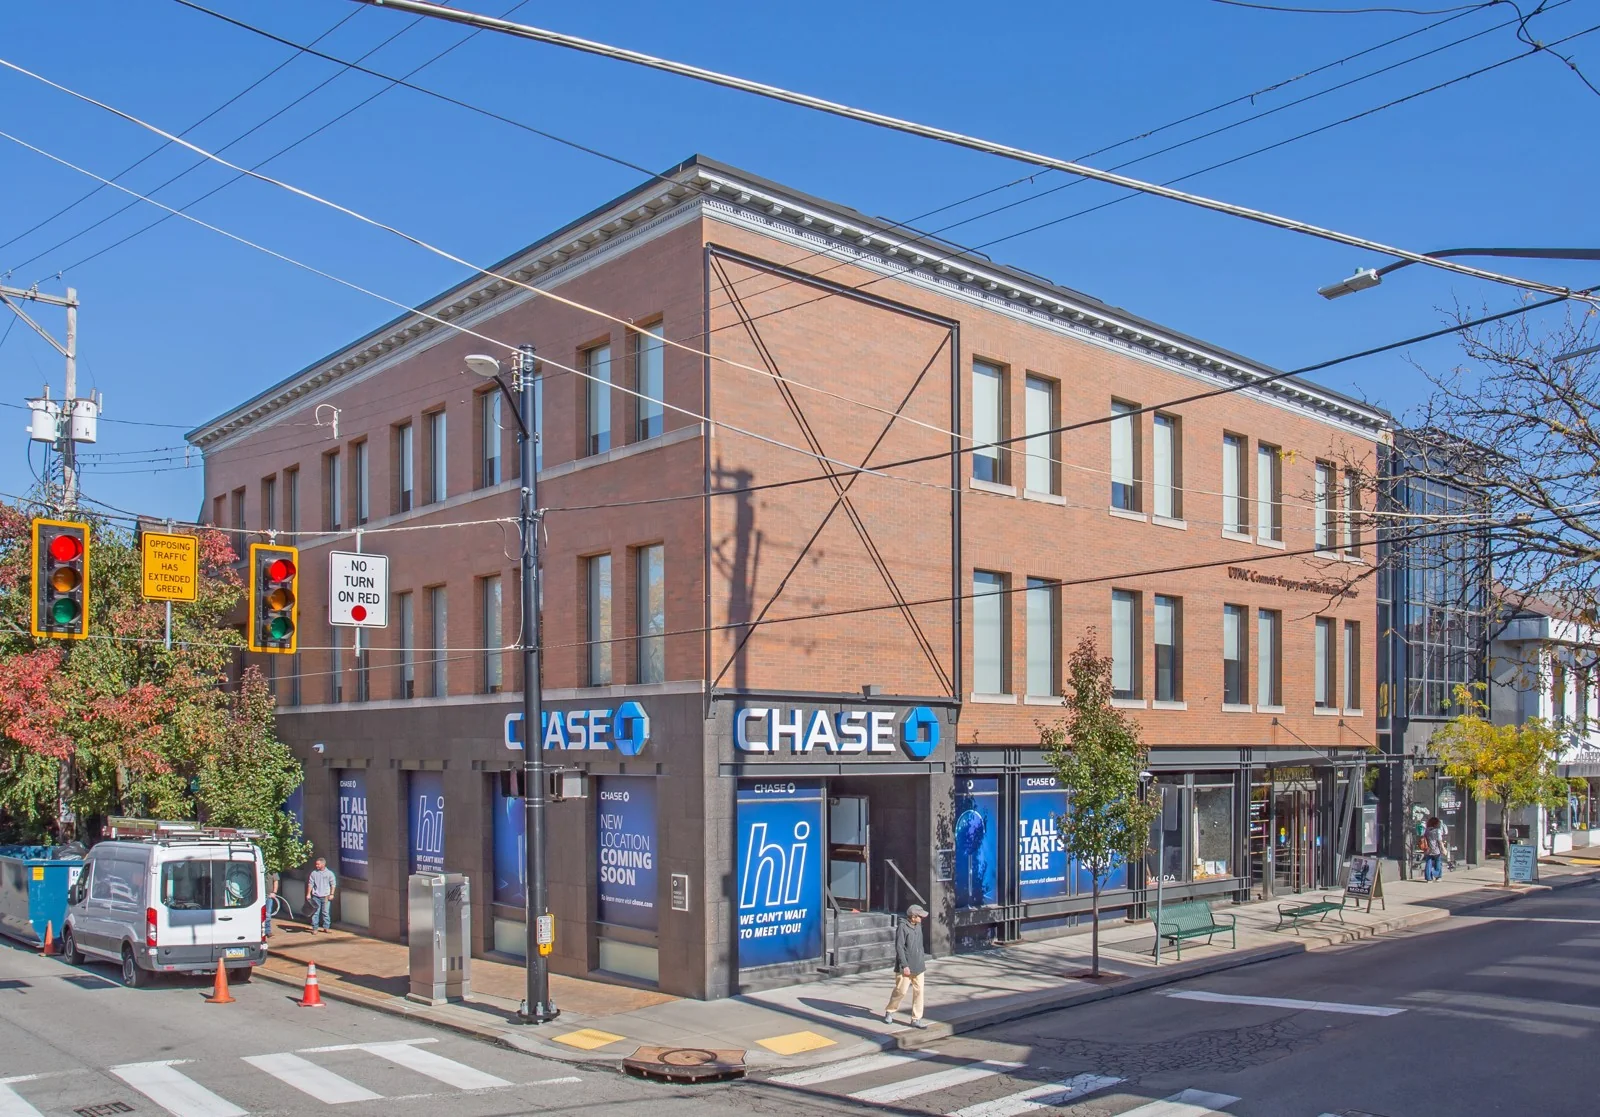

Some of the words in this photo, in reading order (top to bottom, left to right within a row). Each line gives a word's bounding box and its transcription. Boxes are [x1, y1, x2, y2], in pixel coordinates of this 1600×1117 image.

[150, 540, 191, 551] OPPOSING
[153, 551, 187, 561] TRAFFIC
[161, 563, 178, 571] HAS
[351, 560, 367, 572] NO
[148, 573, 191, 583] EXTENDED
[344, 575, 374, 588] TURN
[156, 585, 183, 594] GREEN
[338, 591, 354, 602] ON
[358, 592, 380, 604] RED
[504, 709, 614, 750] CASE
[733, 708, 897, 752] CHASE
[340, 780, 353, 788] CHASE
[754, 783, 786, 793] CHASE
[1026, 778, 1049, 787] CHASE
[600, 791, 623, 801] CHASE
[340, 797, 350, 814] IT
[416, 795, 445, 853] hi
[601, 814, 623, 830] NEW
[1031, 818, 1057, 836] ALL
[341, 831, 364, 850] HERE
[601, 831, 650, 851] LOCATION
[600, 848, 652, 869] COMING
[740, 821, 810, 909] hi
[600, 865, 636, 886] SOON
[632, 899, 653, 908] chase.com
[740, 914, 754, 925] WE
[756, 911, 782, 924] CAN'T
[784, 908, 807, 921] WAIT
[740, 928, 752, 939] TO
[754, 925, 778, 938] MEET
[780, 922, 802, 934] YOU!
